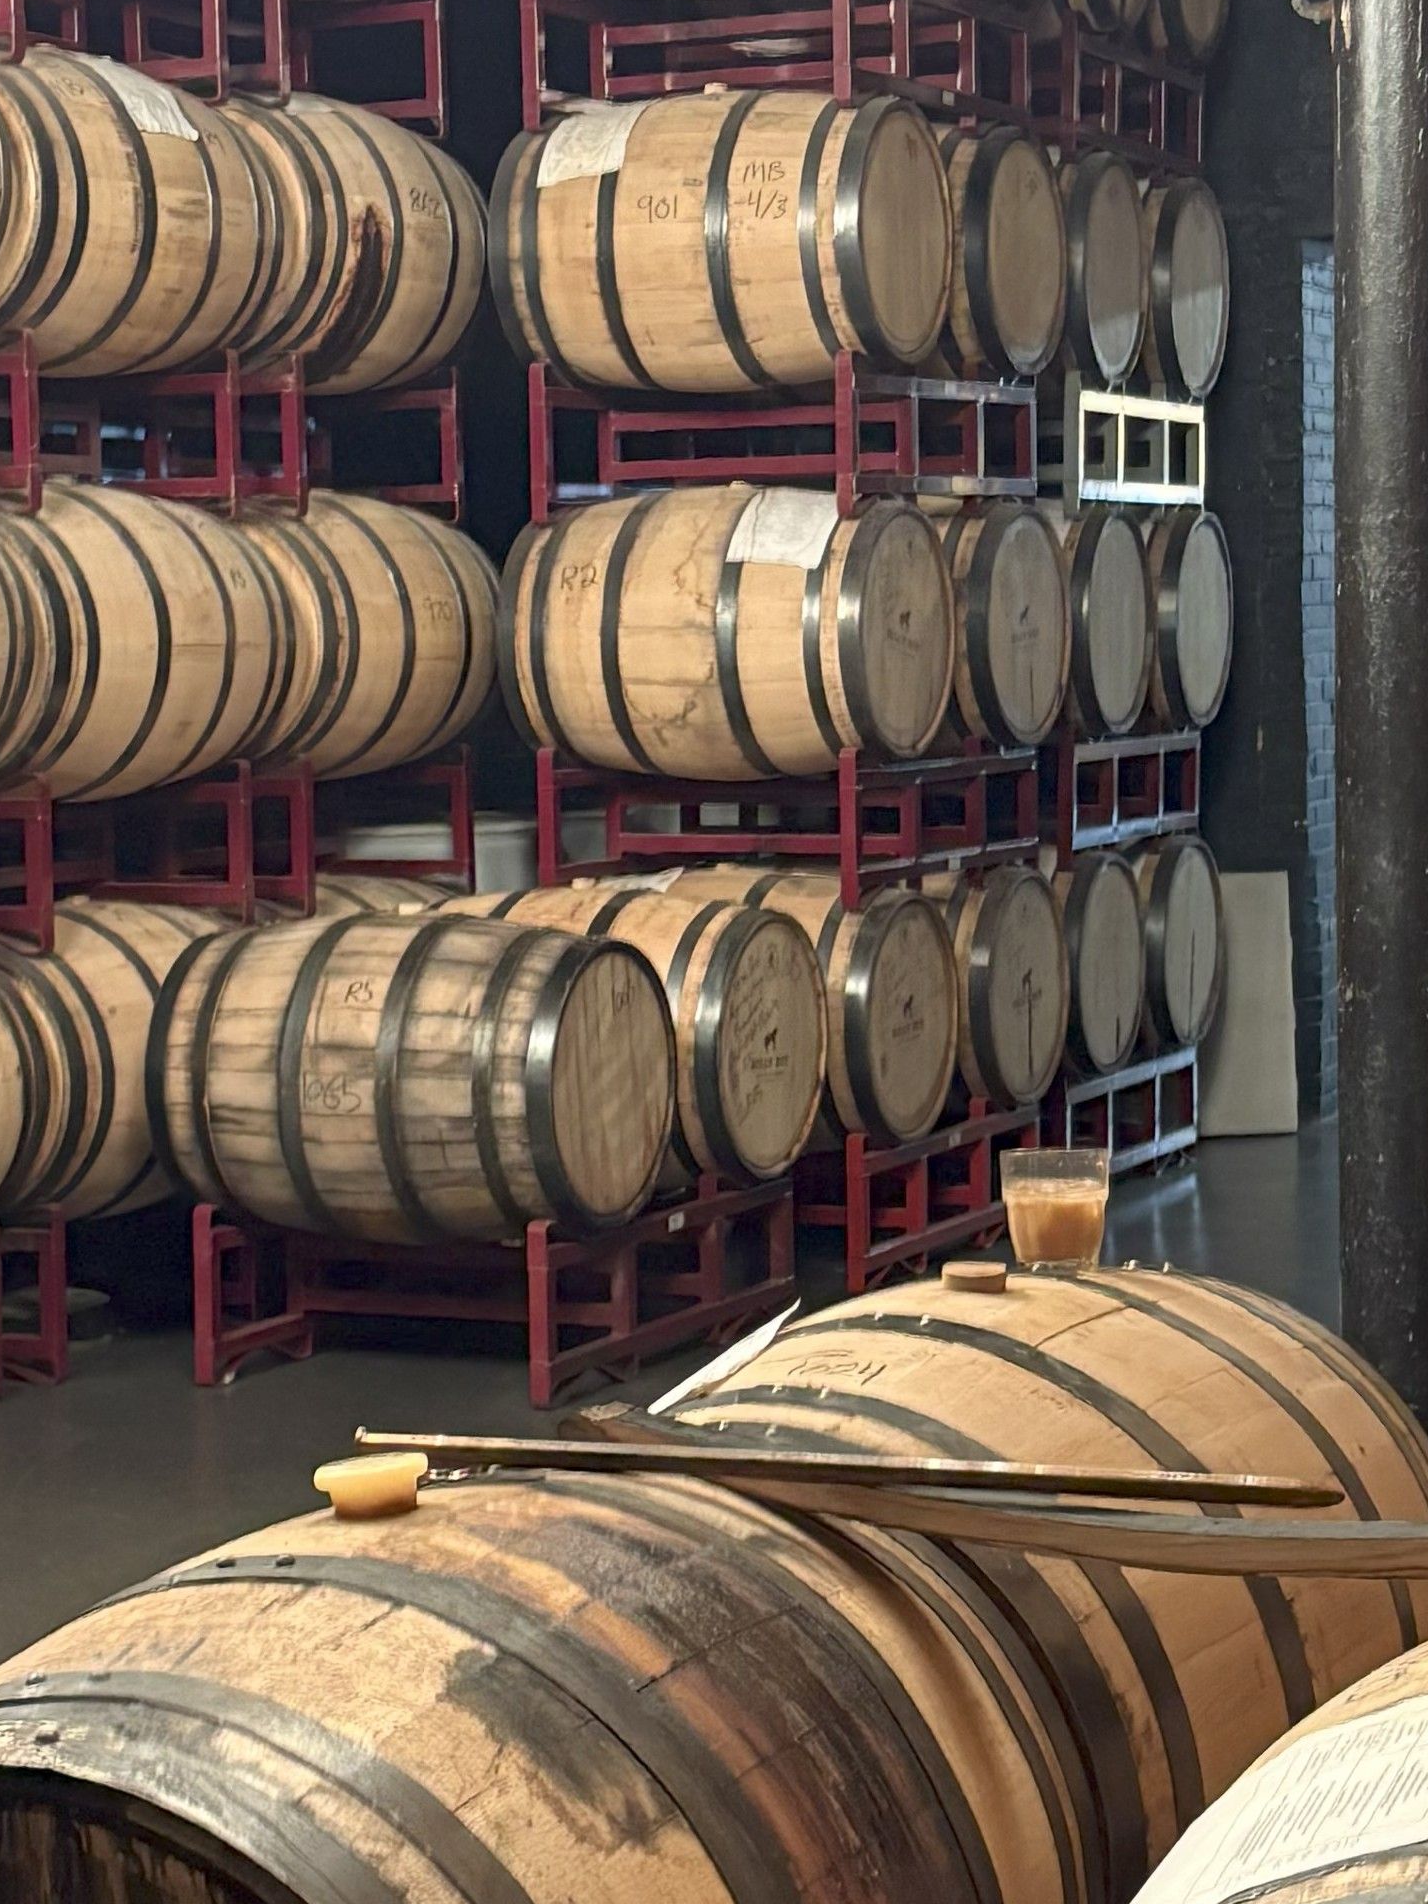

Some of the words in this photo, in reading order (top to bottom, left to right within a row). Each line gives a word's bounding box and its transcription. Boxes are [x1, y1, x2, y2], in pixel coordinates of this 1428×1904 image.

[743, 160, 786, 184] MB
[636, 193, 678, 224] 901
[559, 558, 599, 592] R2
[302, 1070, 363, 1114] 1065
